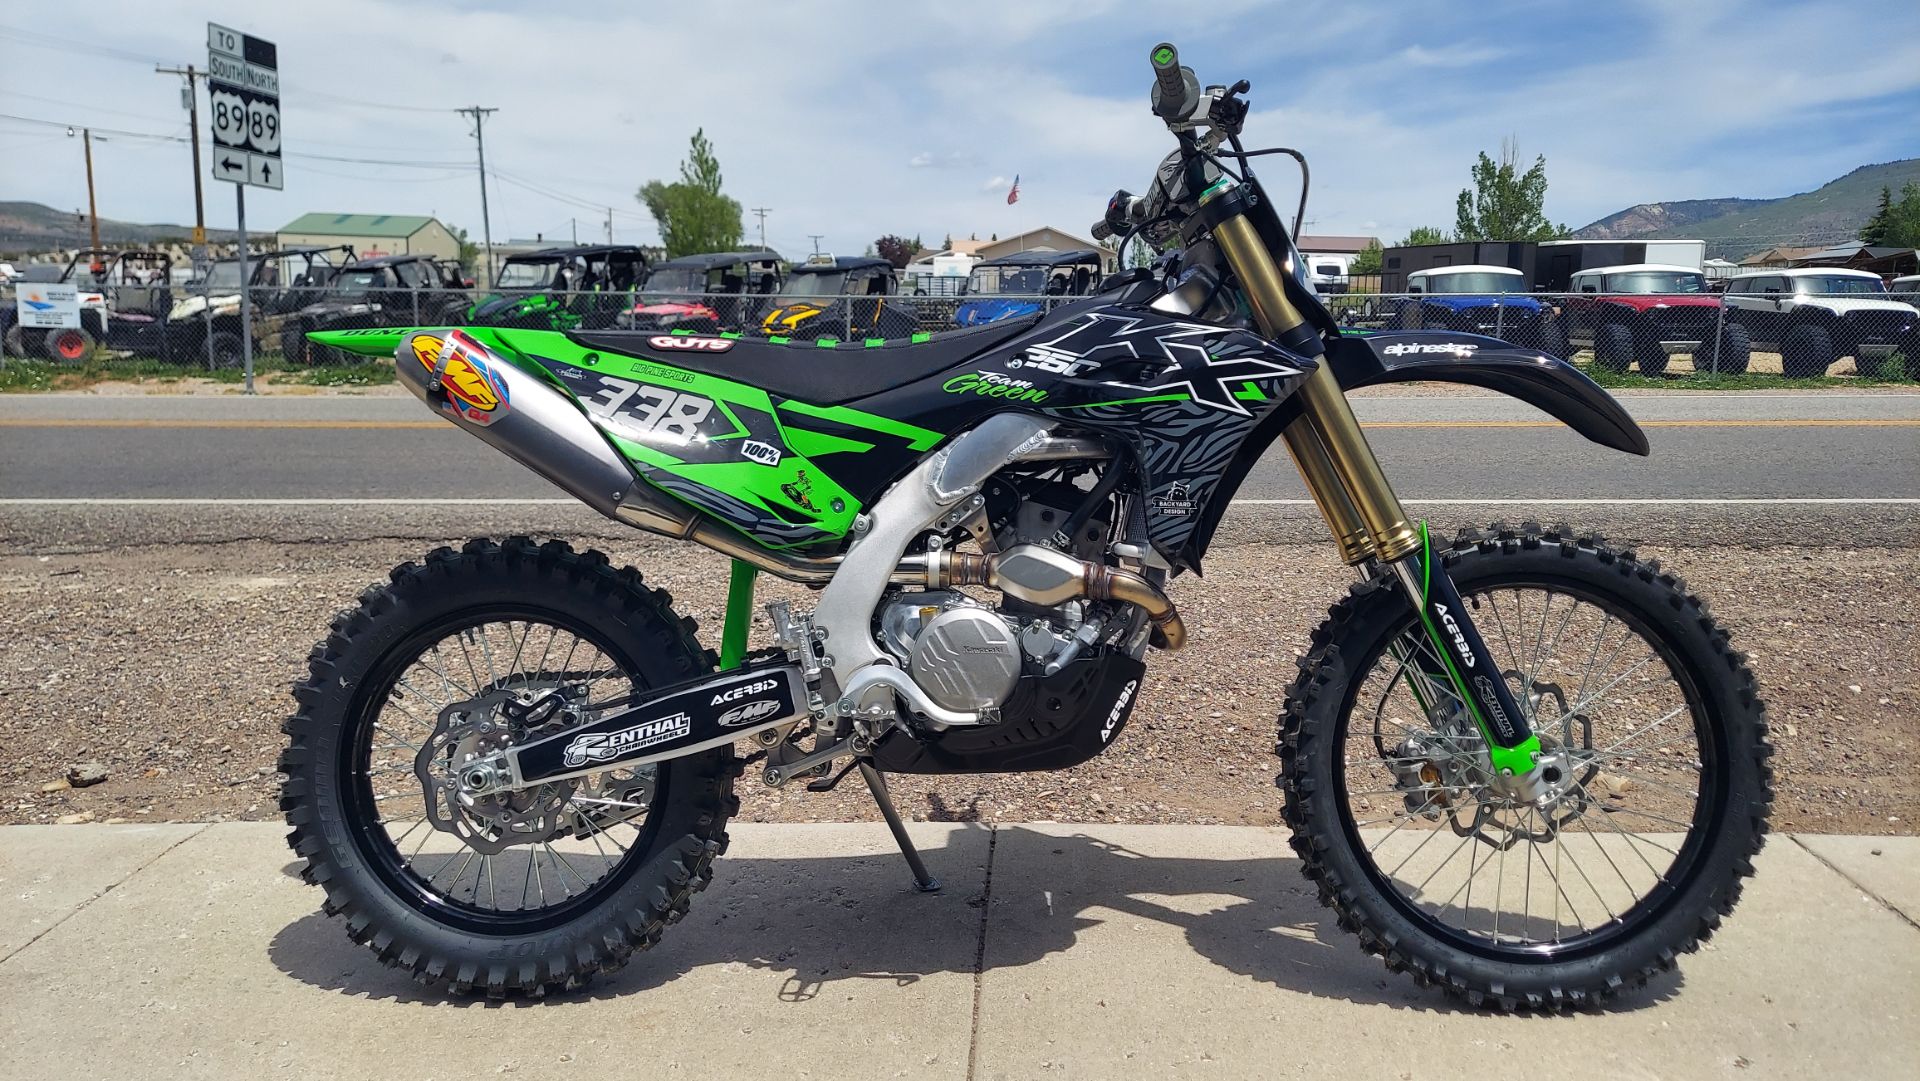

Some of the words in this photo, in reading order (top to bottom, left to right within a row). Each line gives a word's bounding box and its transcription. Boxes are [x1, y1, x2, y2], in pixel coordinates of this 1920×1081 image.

[218, 31, 235, 51] TO
[211, 57, 244, 82] SOUTH
[246, 69, 278, 91] NORTH
[216, 102, 244, 132] 89
[251, 111, 277, 140] 89
[650, 336, 733, 350] GUTS
[630, 363, 646, 374] BIG
[645, 365, 664, 378] PINE
[662, 368, 696, 384] SPORTS
[977, 369, 1033, 389] Team
[942, 373, 1050, 404] Green
[577, 376, 714, 447] 338
[744, 442, 778, 463] 100%
[719, 700, 779, 726] FMF
[567, 715, 688, 765] RENTHAL
[619, 728, 688, 752] CHAINWHEELS
